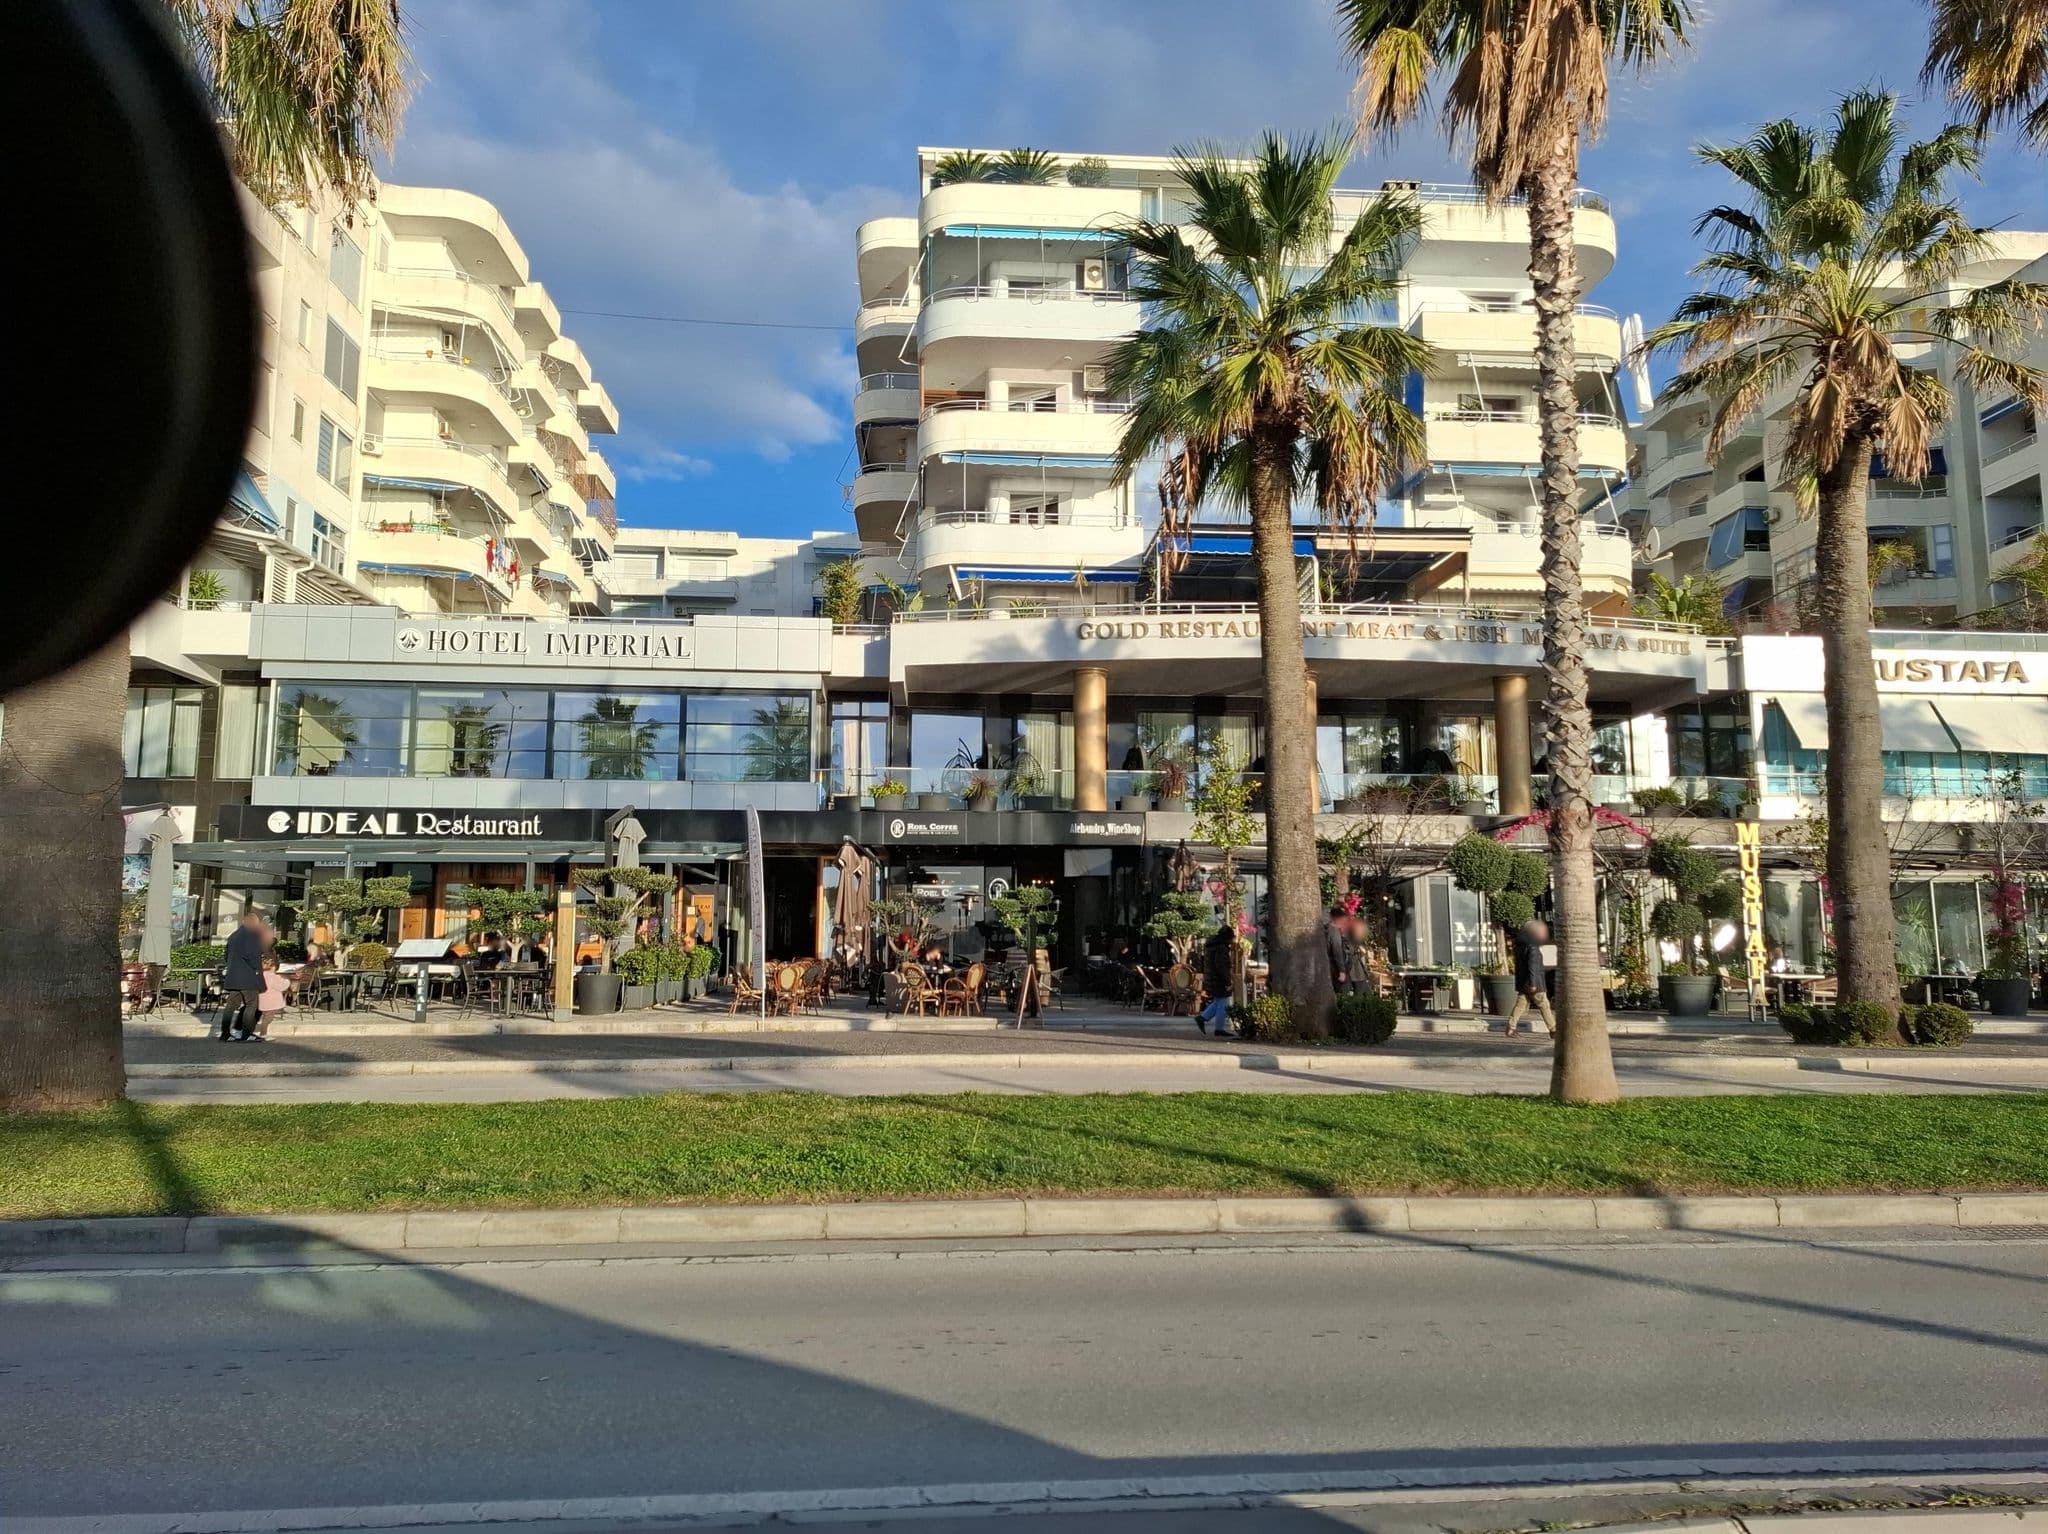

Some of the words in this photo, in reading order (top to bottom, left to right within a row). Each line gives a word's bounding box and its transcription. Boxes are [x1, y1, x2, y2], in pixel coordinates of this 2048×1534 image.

[427, 630, 529, 655] HOTEL
[544, 632, 692, 659] IMPERIAL
[1077, 621, 1150, 641] GOLD
[1159, 620, 1337, 639] RESTAUNT
[1346, 622, 1414, 640] MEAT
[1424, 624, 1443, 641] &
[1455, 625, 1508, 644] FISH
[1521, 627, 1630, 651] MAFA
[1637, 638, 1691, 656] SUITE
[1872, 658, 2031, 684] USTAFA
[296, 811, 408, 836] IDEAL
[415, 813, 543, 836] Restaurant
[1735, 822, 1770, 1006] MUSTAFA
